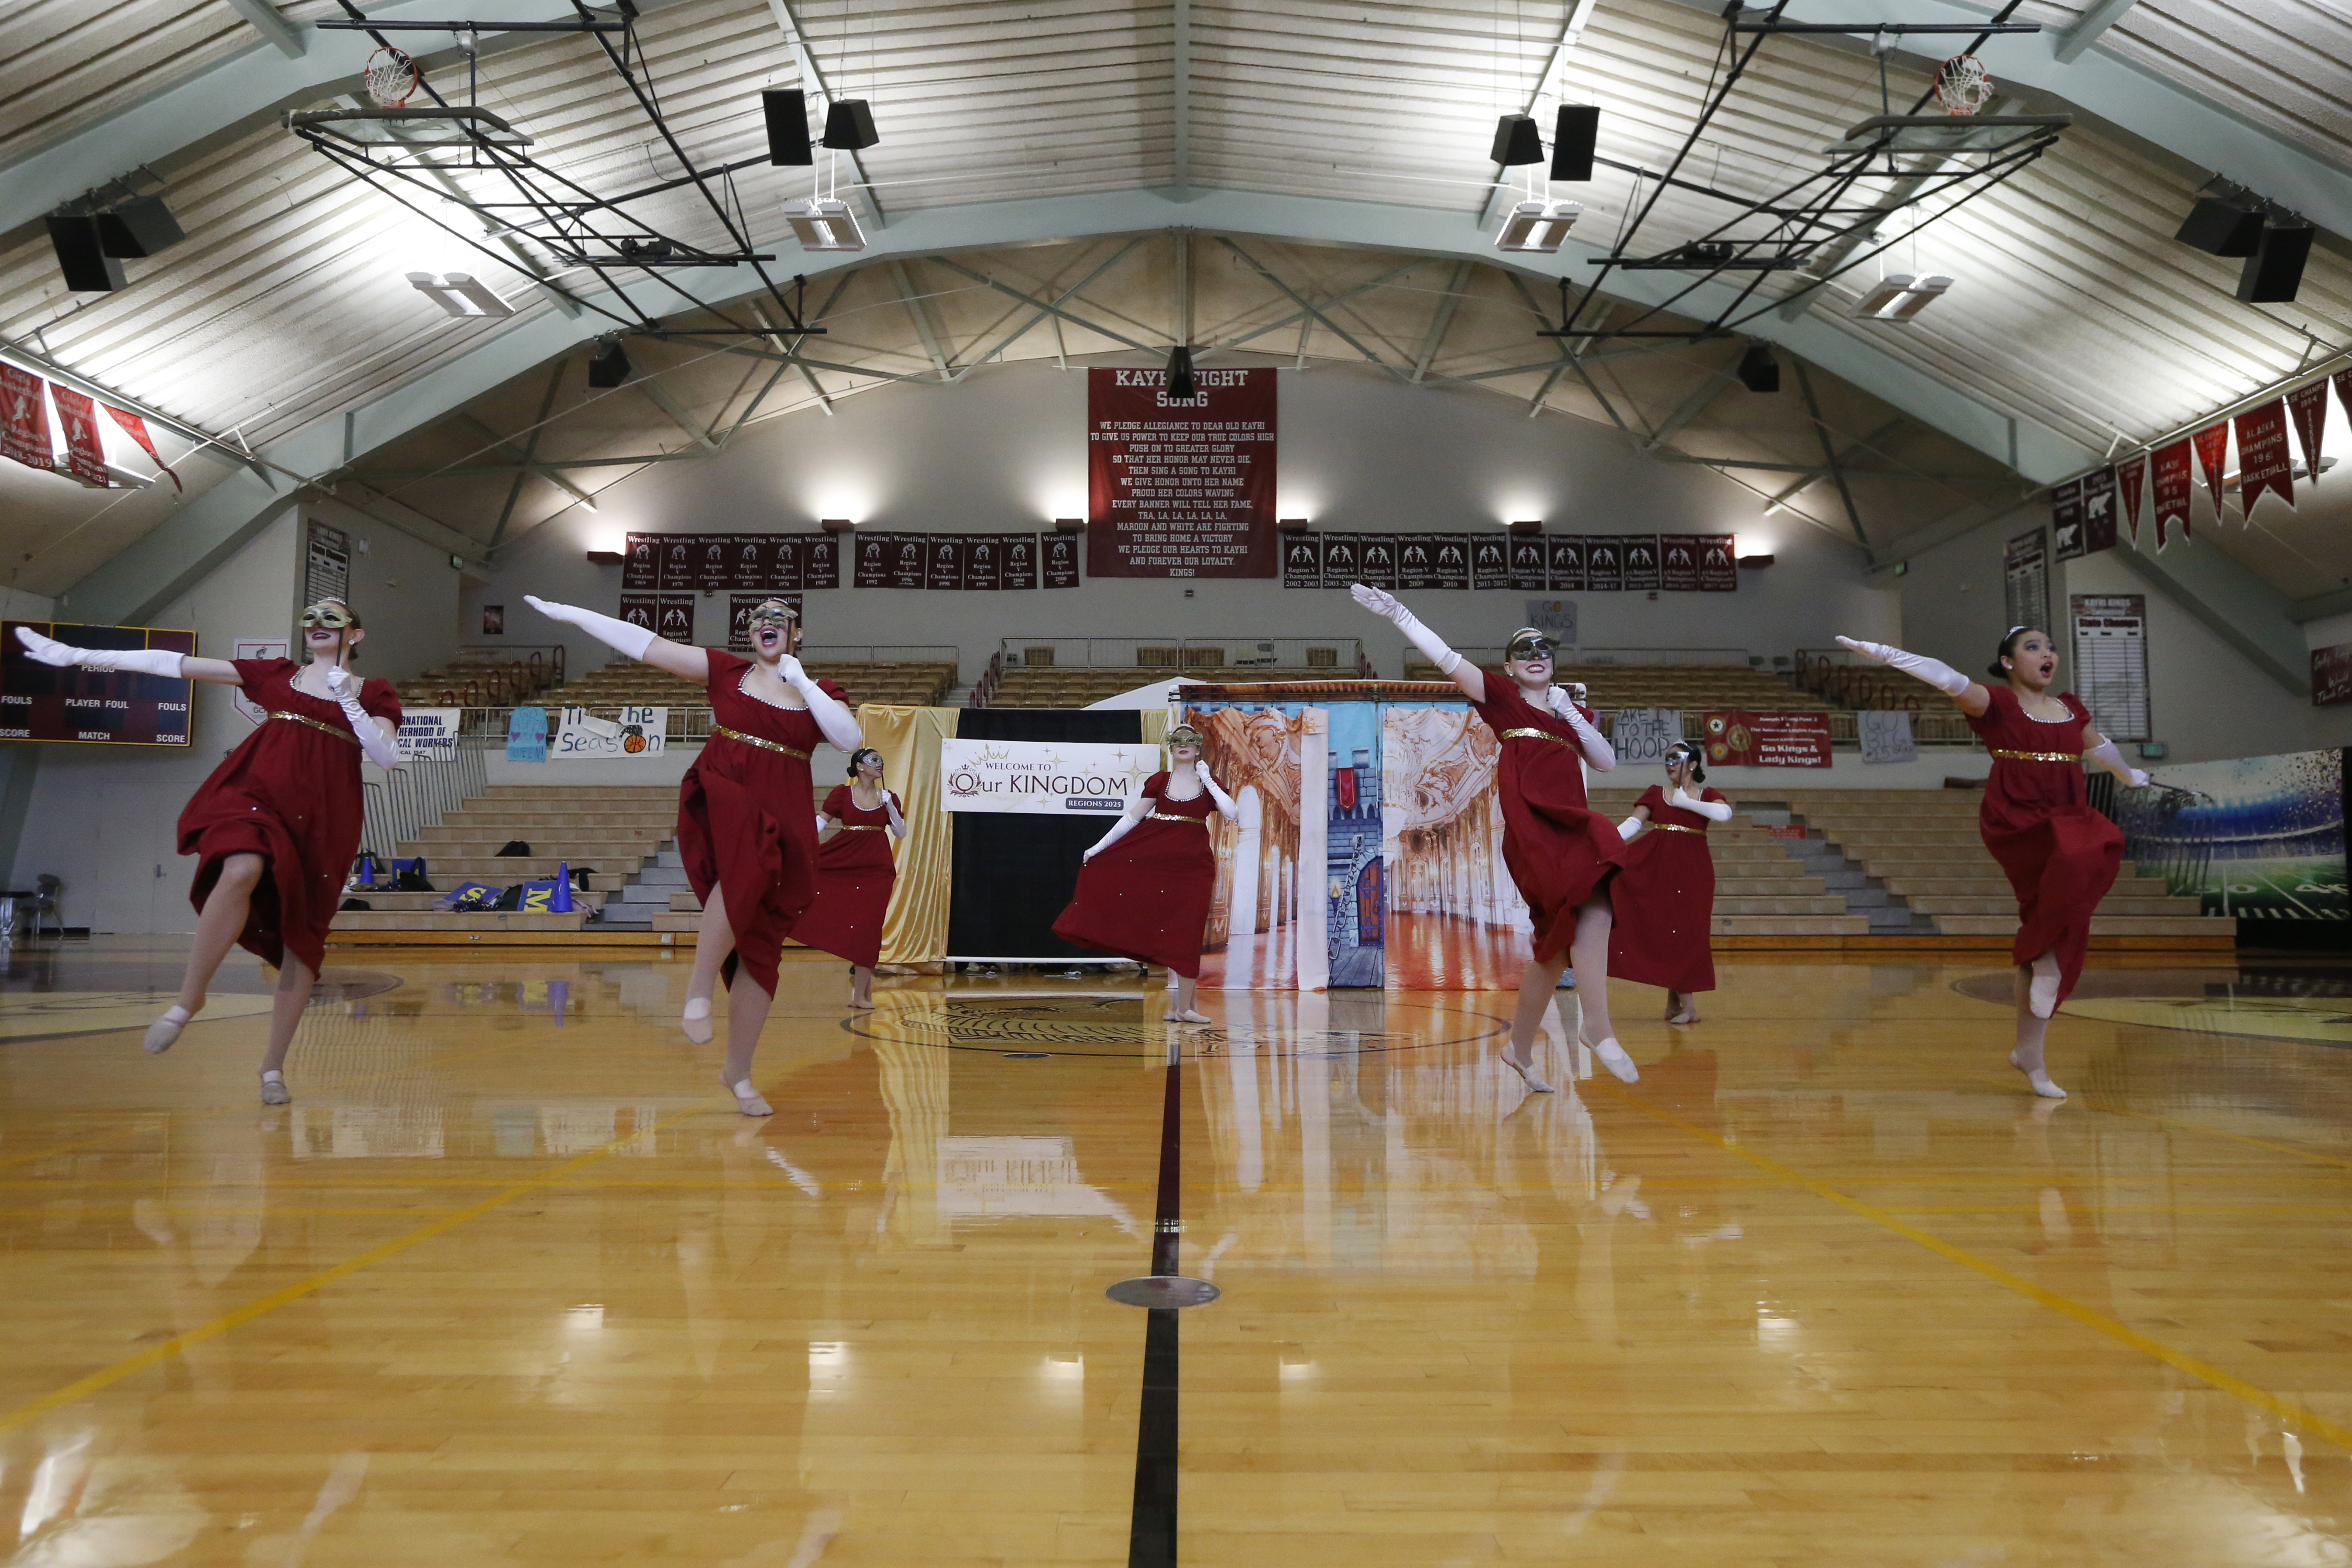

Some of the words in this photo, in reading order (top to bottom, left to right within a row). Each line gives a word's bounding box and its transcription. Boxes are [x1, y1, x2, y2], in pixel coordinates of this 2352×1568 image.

[1115, 371, 1167, 386] KAY
[1157, 391, 1208, 407] SONG
[1099, 421, 1112, 430] WE
[1113, 421, 1141, 430] PLEDGE
[1143, 422, 1189, 430] ALLEGIANCE
[1191, 422, 1201, 430] TO
[1203, 422, 1223, 430] DEAR
[1226, 422, 1239, 430] OLD
[1242, 421, 1265, 430] KAYHI
[1090, 432, 1099, 441] TO
[1102, 432, 1119, 441] GIVE
[1132, 433, 1157, 441] POWER
[1229, 433, 1254, 441] COLORS
[1129, 444, 1149, 453] PUSH
[1175, 444, 1209, 453] GREATER
[1212, 444, 1235, 453] GLORY
[1112, 455, 1122, 463] SO
[1124, 455, 1144, 463] THAT
[1146, 455, 1161, 464] HER
[1163, 455, 1189, 464] HONOR
[1191, 455, 1208, 464] MAY
[1210, 455, 1235, 464] NEVER
[1128, 466, 1149, 475] THEN
[1151, 466, 1169, 475] SING
[1170, 466, 1177, 475] A
[1179, 466, 1198, 475] SONG
[1212, 466, 1236, 475] KAYHI
[1120, 477, 1133, 486] WE
[1135, 477, 1152, 486] GIVE
[1155, 478, 1180, 486] HONOR
[1182, 478, 1202, 486] UNTO
[1204, 478, 1219, 486] HER
[1222, 478, 1244, 486] NAME
[1131, 488, 1155, 497] PROUD
[1158, 489, 1173, 497] HER
[1175, 489, 1203, 497] COLORS
[1205, 489, 1234, 497] WAVING
[1112, 500, 1137, 508] EVERY
[1139, 500, 1170, 508] BANNER
[1192, 500, 1211, 509] TELL
[1213, 500, 1228, 509] HER
[1117, 522, 1149, 531] MAROON
[1169, 523, 1194, 531] WHITE
[1196, 523, 1212, 531] ARE
[1214, 523, 1249, 531] FIGHTING
[628, 536, 660, 544] Wrestling
[1132, 534, 1142, 542] TO
[1145, 534, 1167, 542] BRING
[1170, 534, 1191, 543] HOME
[1193, 534, 1200, 543] A
[1201, 534, 1233, 543] VICTORY
[1118, 545, 1130, 554] WE
[1133, 545, 1160, 554] PLEDGE
[1162, 545, 1178, 554] OUR
[1180, 545, 1209, 554] HEARTS
[1224, 546, 1248, 554] KAYHI
[1129, 557, 1146, 565] AND
[1148, 557, 1182, 565] FOREVER
[1184, 557, 1199, 565] OUR
[1169, 568, 1195, 577] KINGS!
[1, 696, 32, 705] FOULS
[65, 698, 100, 708] PLAYER
[106, 700, 129, 709] FOUL
[158, 702, 187, 711] FOULS
[628, 706, 654, 723] he
[401, 716, 443, 725] RNATIONAL
[0, 729, 30, 737] SCORE
[398, 727, 434, 737] HERHOOD
[437, 727, 446, 736] OF
[1618, 723, 1639, 736] TO
[1641, 722, 1671, 736] THE
[78, 731, 110, 741] MATCH
[156, 734, 186, 743] SCORE
[415, 737, 453, 748] WORKERS
[1615, 737, 1669, 759] HOOP
[1778, 744, 1808, 754] Kings
[1759, 755, 1785, 765] Lady
[1787, 756, 1821, 765] Kings!
[986, 762, 1035, 771] WELCOME
[1010, 775, 1128, 795] KINGDOM
